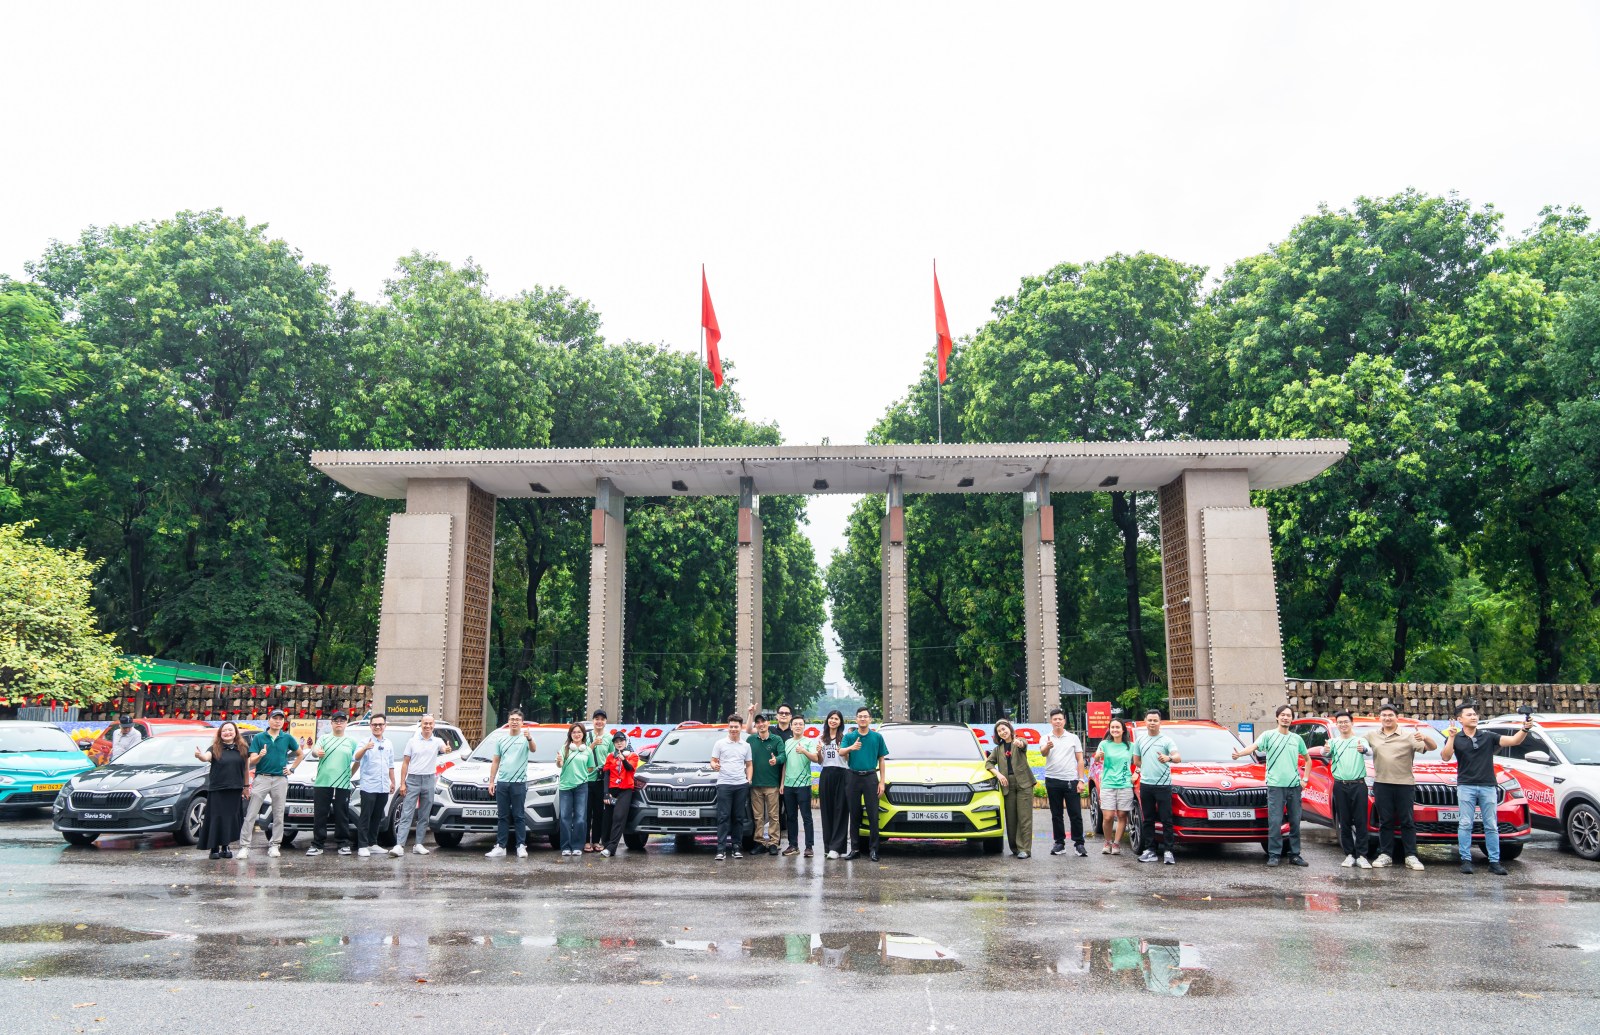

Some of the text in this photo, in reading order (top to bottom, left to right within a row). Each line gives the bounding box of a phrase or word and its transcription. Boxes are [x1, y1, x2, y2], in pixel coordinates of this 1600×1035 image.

[387, 704, 426, 713] THỐNG NHẤT
[826, 750, 836, 759] 98
[99, 812, 113, 820] Style
[661, 809, 697, 817] 35A-490.58
[911, 812, 949, 820] 30M-466.46
[1211, 811, 1252, 819] 30F-109.96
